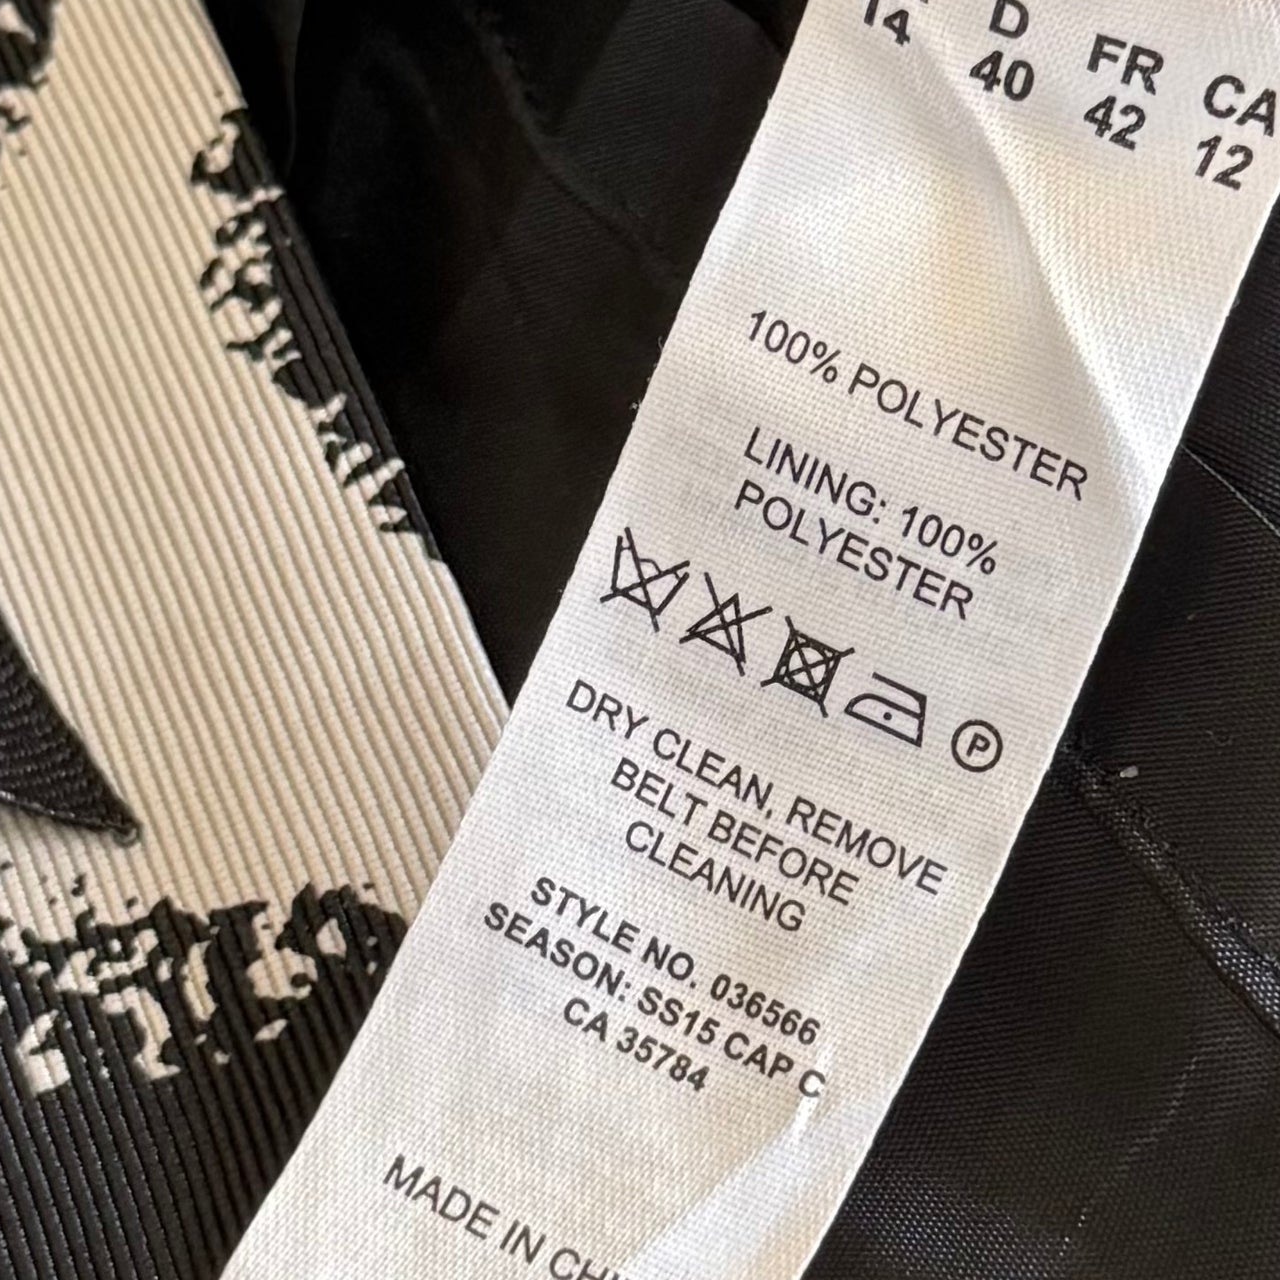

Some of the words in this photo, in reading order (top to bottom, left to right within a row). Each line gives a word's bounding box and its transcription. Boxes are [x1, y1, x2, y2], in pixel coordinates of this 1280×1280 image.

[969, 50, 1035, 101] 40
[1084, 96, 1146, 150] 42
[1195, 136, 1253, 191] 12
[1087, 34, 1164, 94] FR
[1204, 75, 1278, 137] CA
[747, 311, 842, 383] 100%
[848, 363, 1088, 501] POLYESTER
[733, 480, 973, 620] POLYESTER
[743, 427, 887, 524] LINING:
[901, 505, 998, 575] 100%
[566, 679, 649, 740] DRY
[652, 729, 775, 818] CLEAN,
[786, 796, 948, 895] REMOVE
[611, 758, 709, 826] BELT
[707, 809, 860, 905] BEFORE
[624, 820, 807, 933] CLEANING
[484, 902, 632, 1003] SEASON:
[637, 987, 720, 1043] SS15
[723, 1031, 795, 1079] CAP
[797, 1069, 825, 1098] C
[530, 877, 640, 953] STYLE
[641, 938, 697, 989] NO.
[710, 974, 821, 1045] 036566
[563, 997, 608, 1042] CA
[616, 1025, 710, 1092] 35784
[383, 1154, 500, 1239] MADE
[499, 1220, 546, 1265] IN
